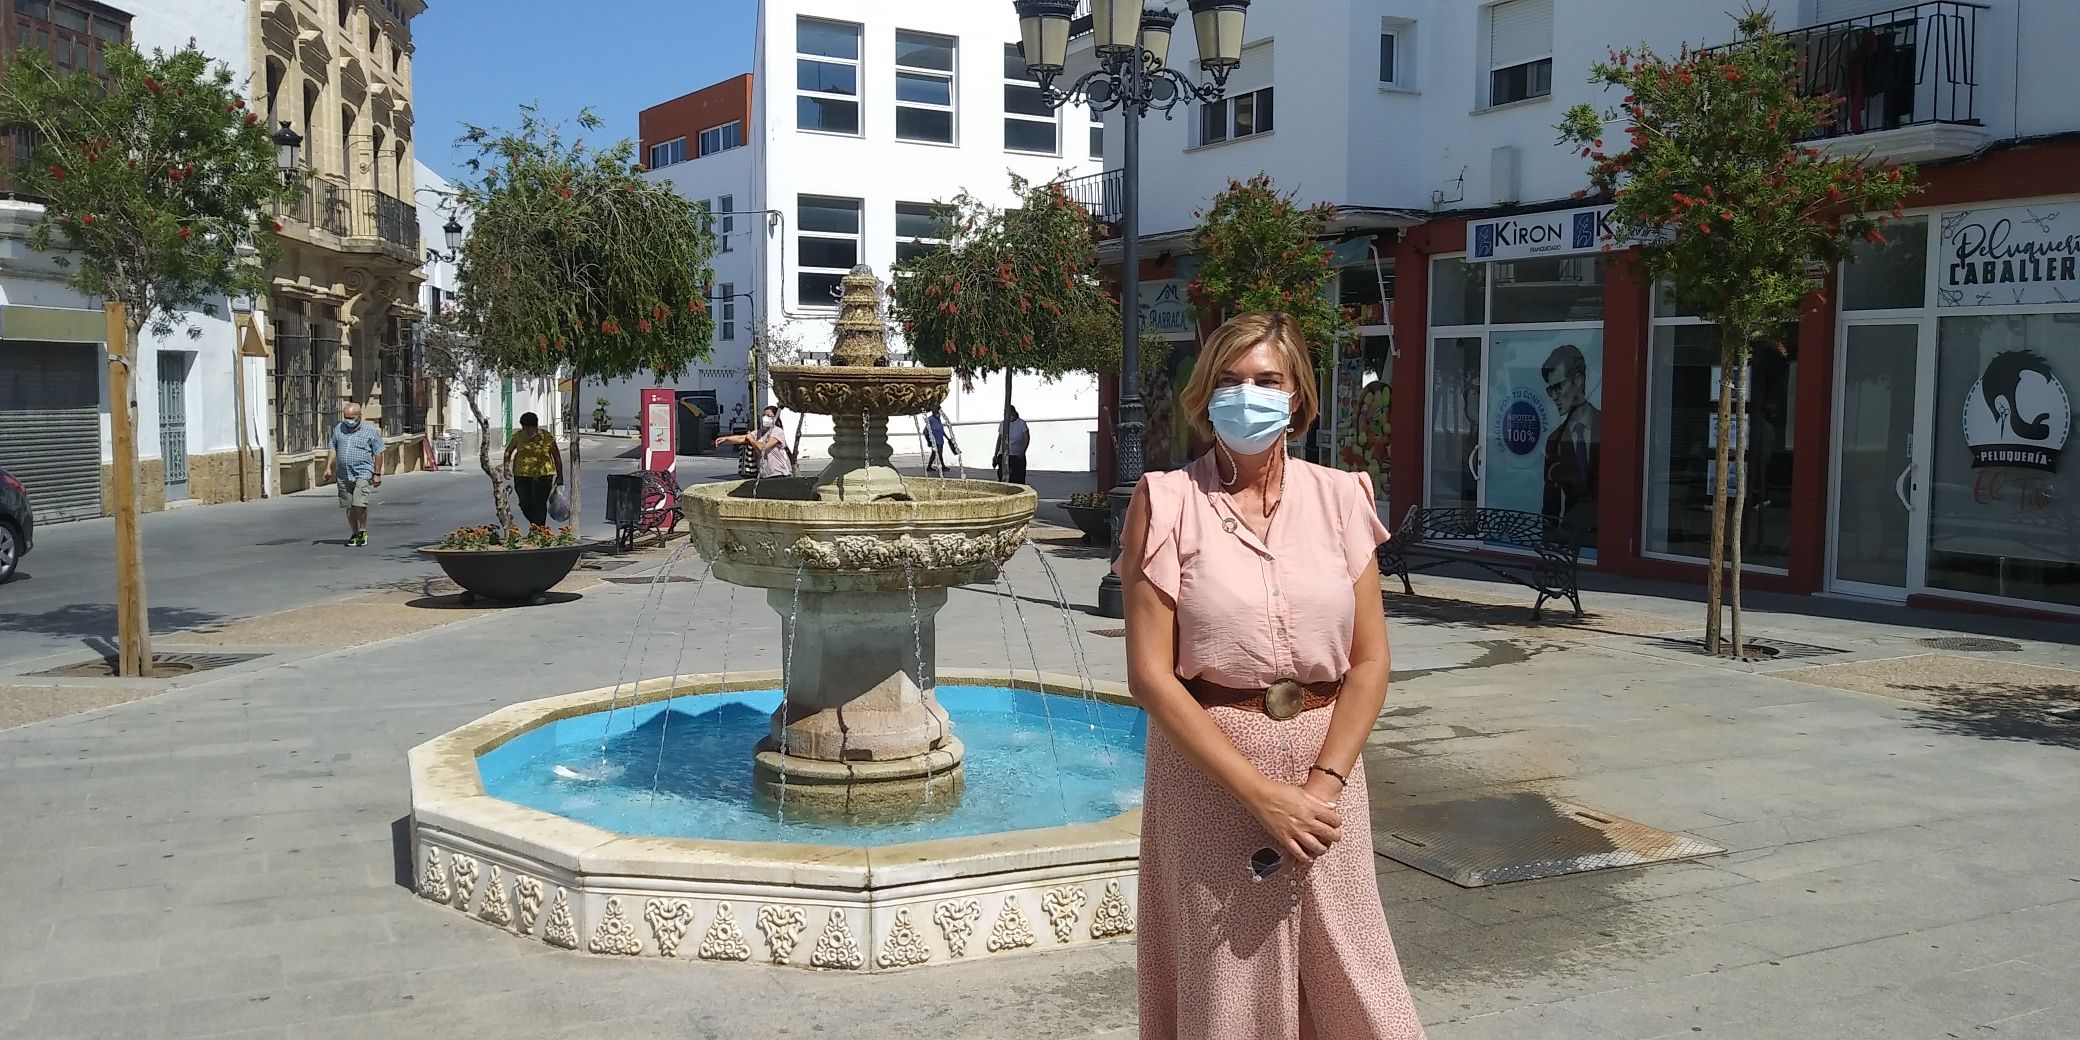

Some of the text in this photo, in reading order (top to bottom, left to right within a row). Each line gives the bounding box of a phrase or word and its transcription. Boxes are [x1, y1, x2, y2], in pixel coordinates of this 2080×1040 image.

[1952, 218, 2080, 269] Peluquerí
[1950, 257, 2076, 286] CABALLER
[1507, 429, 1536, 443] 100%
[1980, 451, 2047, 465] PELUQUERÍA
